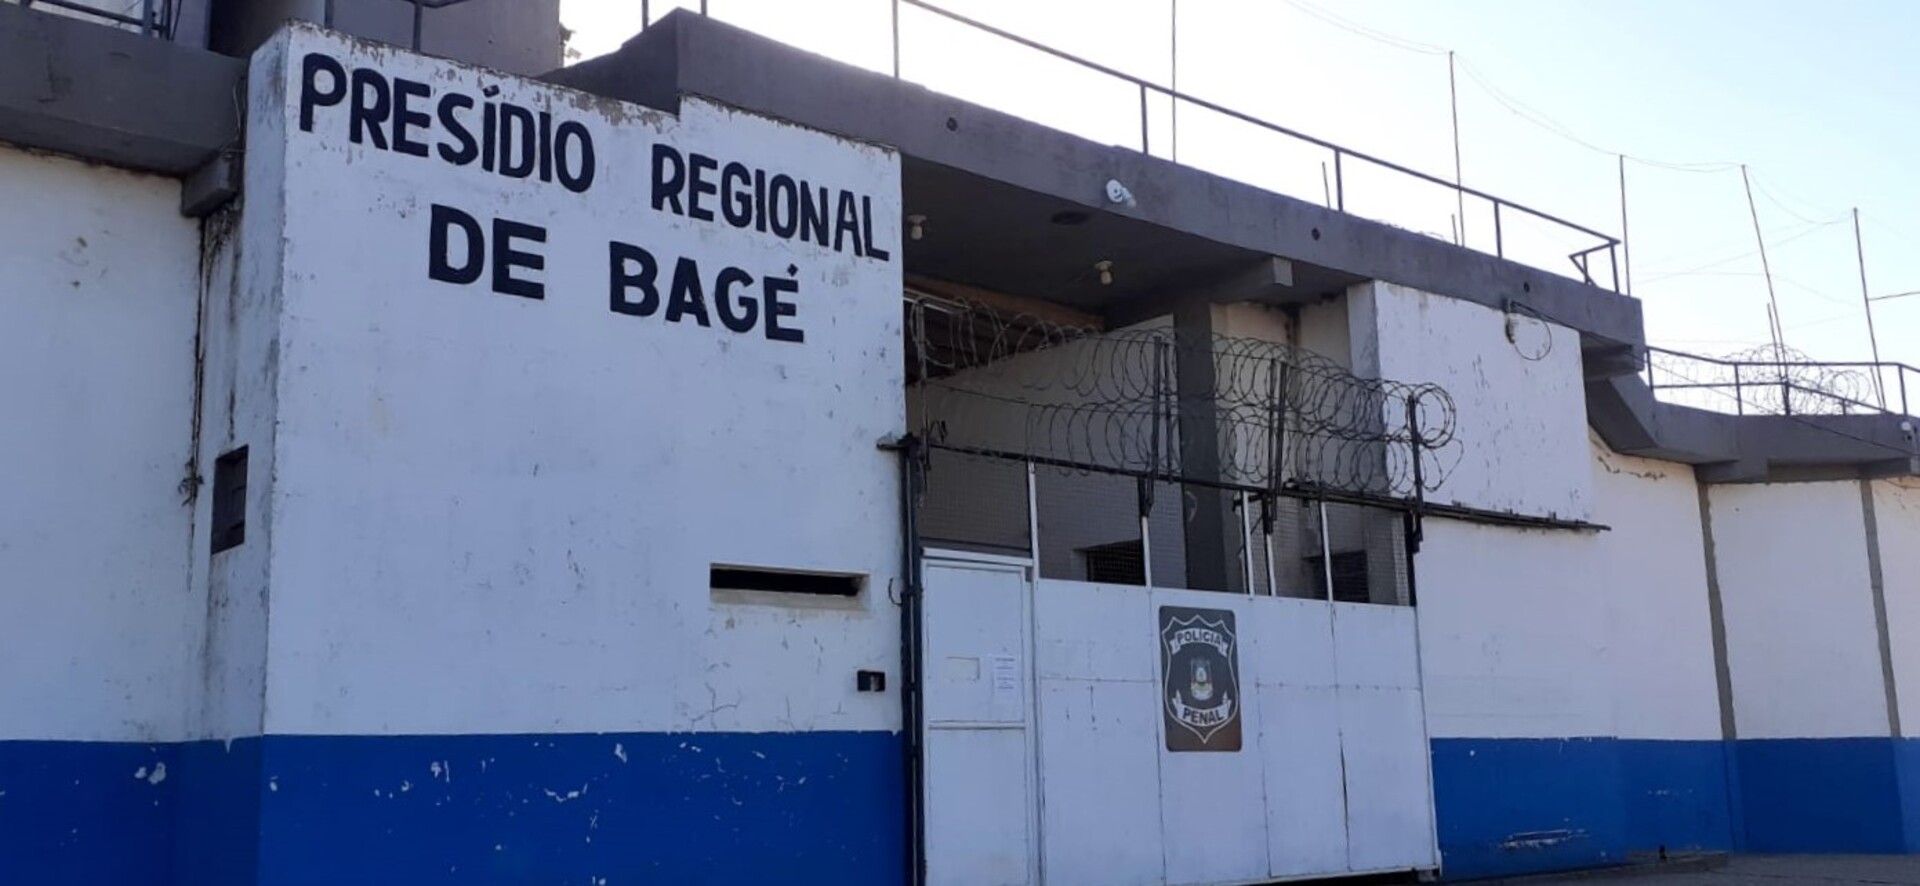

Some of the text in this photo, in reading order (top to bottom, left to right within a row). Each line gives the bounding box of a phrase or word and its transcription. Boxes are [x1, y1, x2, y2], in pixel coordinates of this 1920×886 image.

[300, 52, 890, 262] PRESÍDIO REGIONAL
[428, 203, 805, 343] DE BAGÉ
[1182, 707, 1224, 725] PENAL
